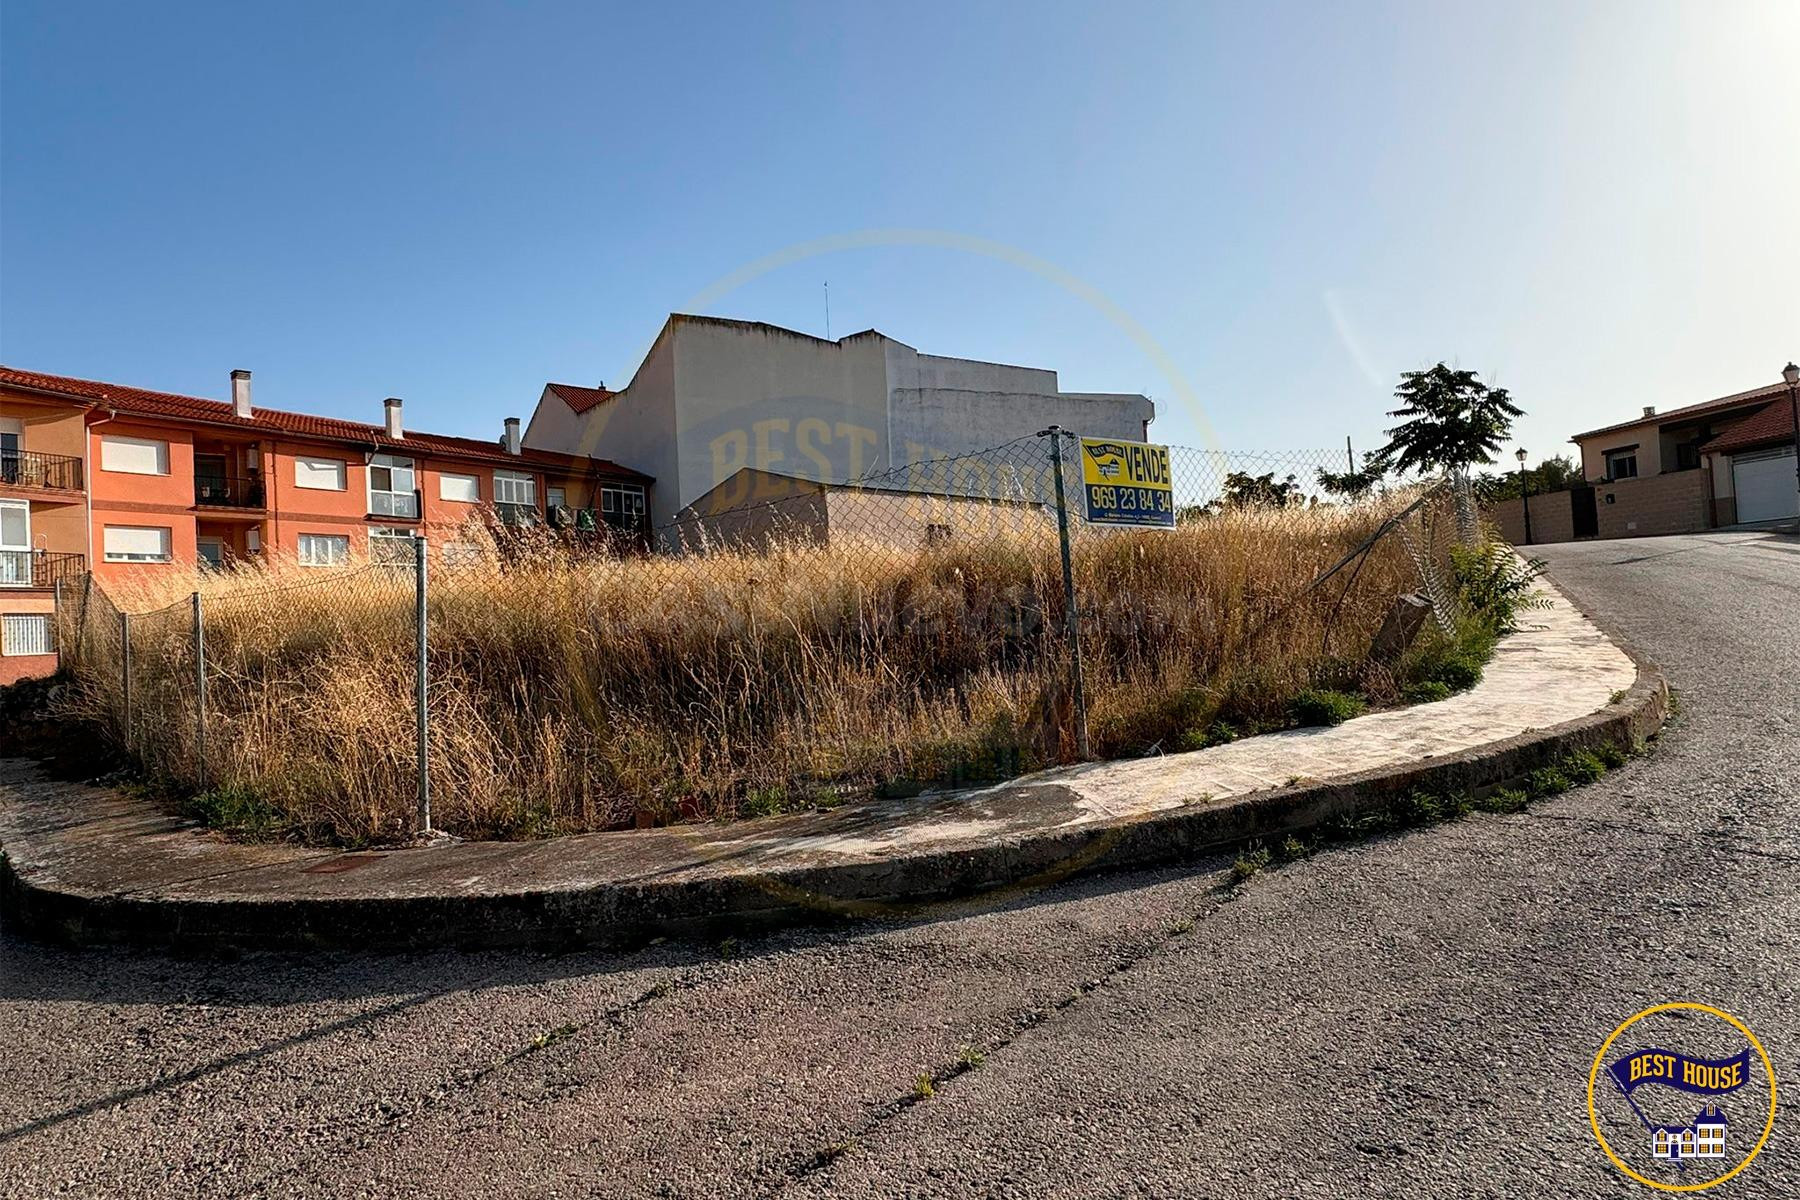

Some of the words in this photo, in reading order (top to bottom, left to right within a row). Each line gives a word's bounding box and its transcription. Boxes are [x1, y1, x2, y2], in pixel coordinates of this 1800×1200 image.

[1124, 445, 1169, 484] VENDE
[1092, 486, 1117, 509] 969
[1120, 488, 1136, 510] 23
[1139, 490, 1154, 511] 84
[1157, 491, 1172, 513] 34
